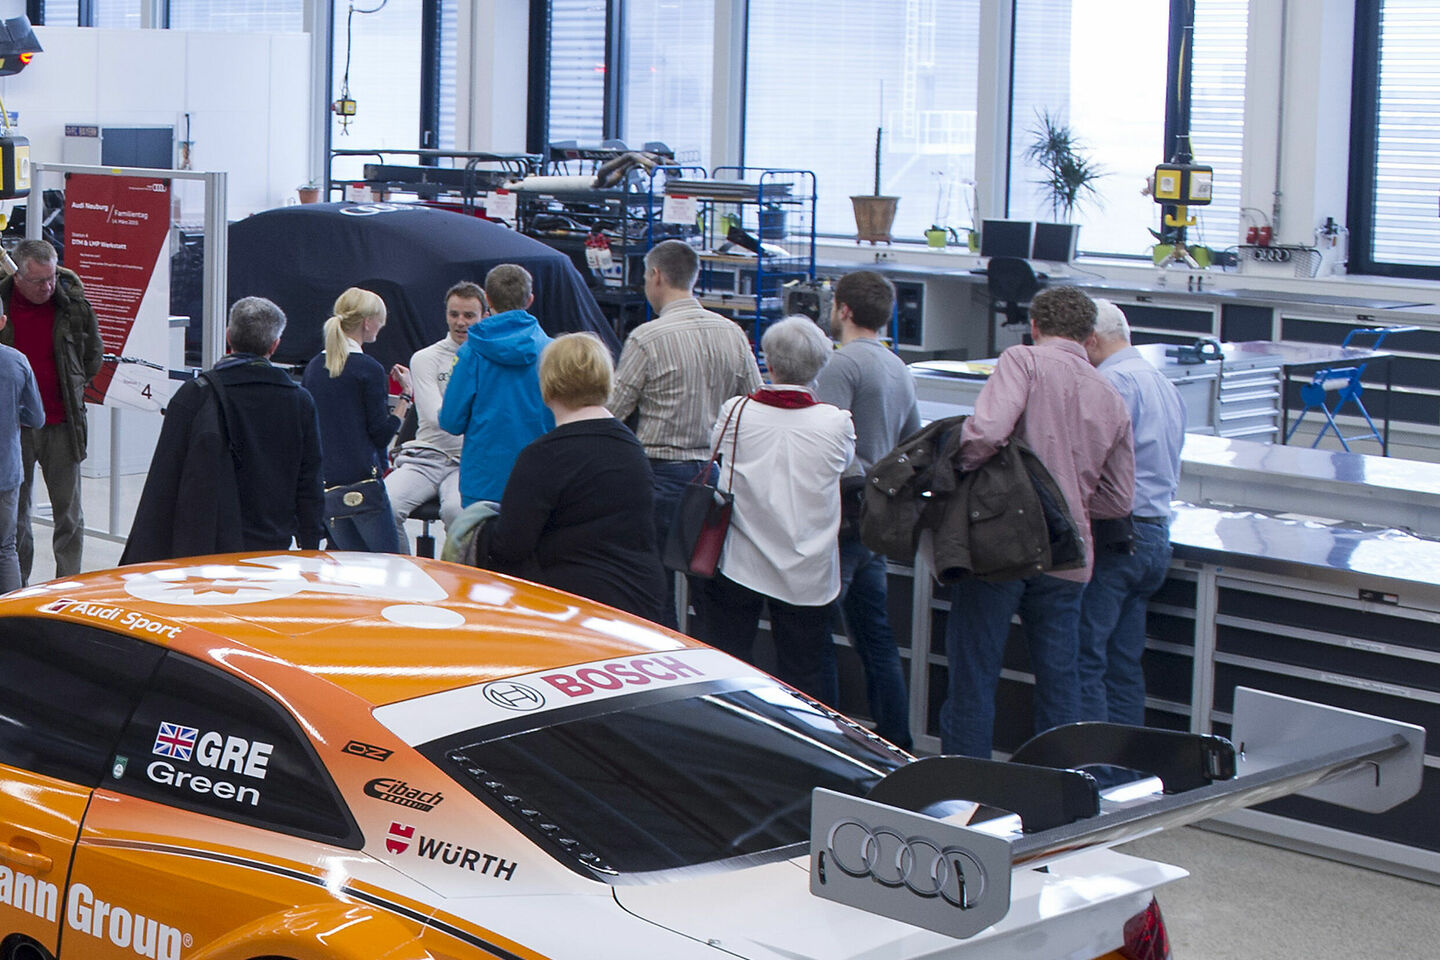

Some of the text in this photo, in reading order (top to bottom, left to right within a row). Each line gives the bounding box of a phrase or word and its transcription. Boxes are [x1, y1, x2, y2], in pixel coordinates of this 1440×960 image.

[141, 383, 153, 400] 4
[70, 601, 183, 640] Audi Sport
[540, 655, 705, 698] BOSCH
[196, 731, 274, 780] GRE
[347, 741, 390, 761] OZ
[146, 761, 261, 807] Green
[363, 777, 444, 807] Eibach
[417, 834, 518, 881] WÜRTH
